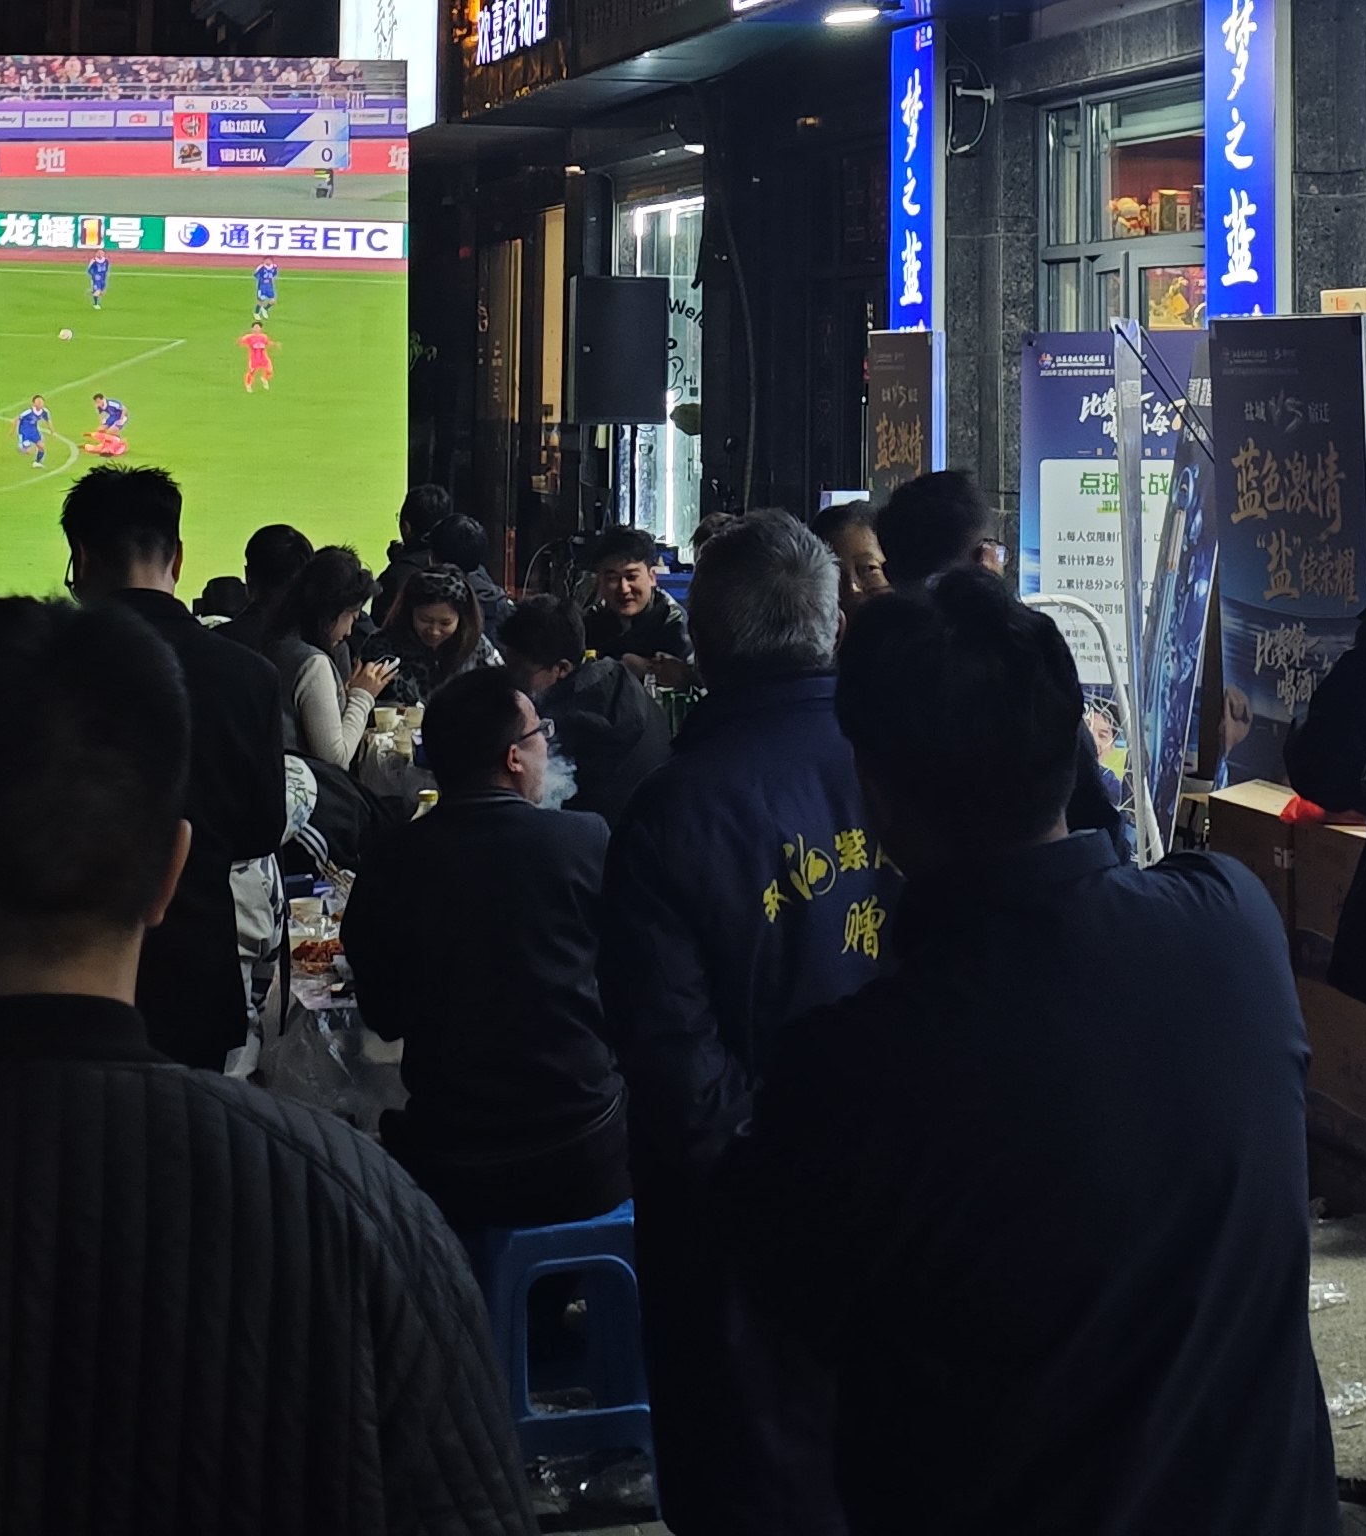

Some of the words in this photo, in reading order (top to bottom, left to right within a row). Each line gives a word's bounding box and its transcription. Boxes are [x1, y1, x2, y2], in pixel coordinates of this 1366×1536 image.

[210, 99, 249, 111] 85:25
[323, 120, 330, 135] 1
[321, 147, 333, 162] 0
[220, 222, 389, 253] 通行宝ETC
[1079, 471, 1172, 495] 点球战
[1230, 437, 1346, 542] 蓝色激情
[841, 895, 886, 961] 赠
